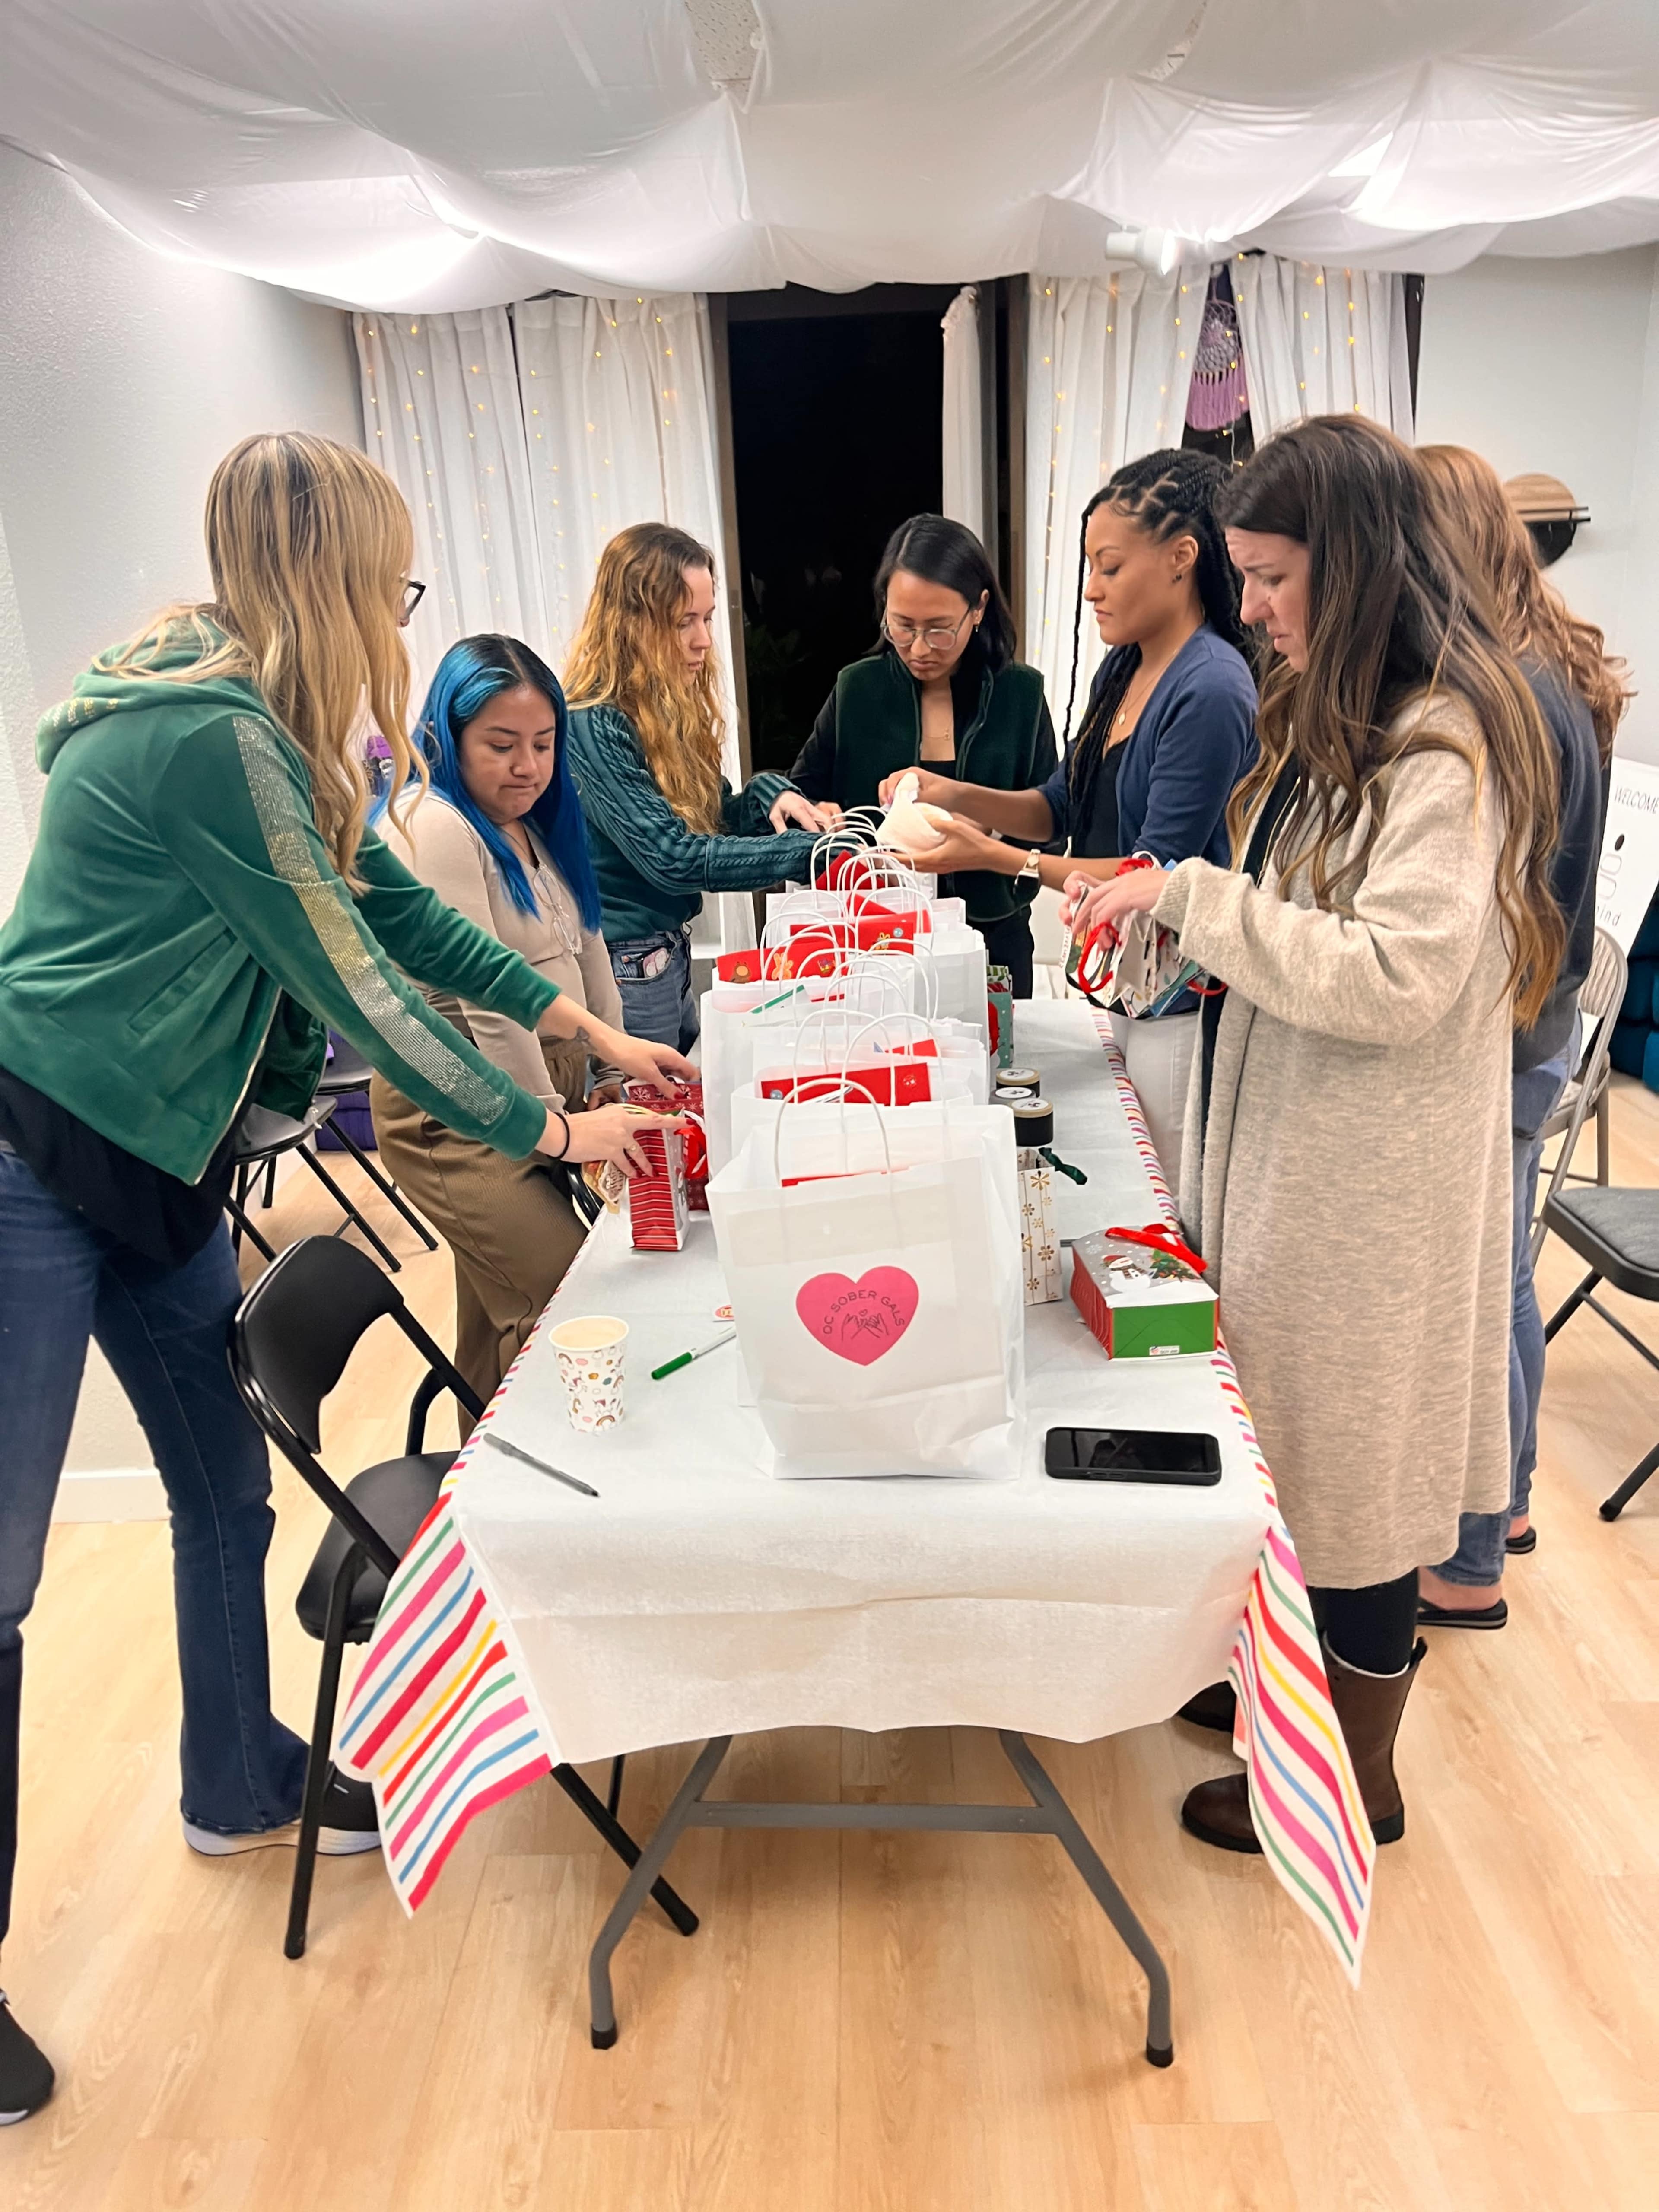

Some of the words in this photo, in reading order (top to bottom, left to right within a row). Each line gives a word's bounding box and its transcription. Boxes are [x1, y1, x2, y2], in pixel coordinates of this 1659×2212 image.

[1596, 903, 1621, 926] ind
[823, 1316, 834, 1335] OC
[831, 1290, 877, 1313] SOBER
[881, 1297, 905, 1326] GALS
